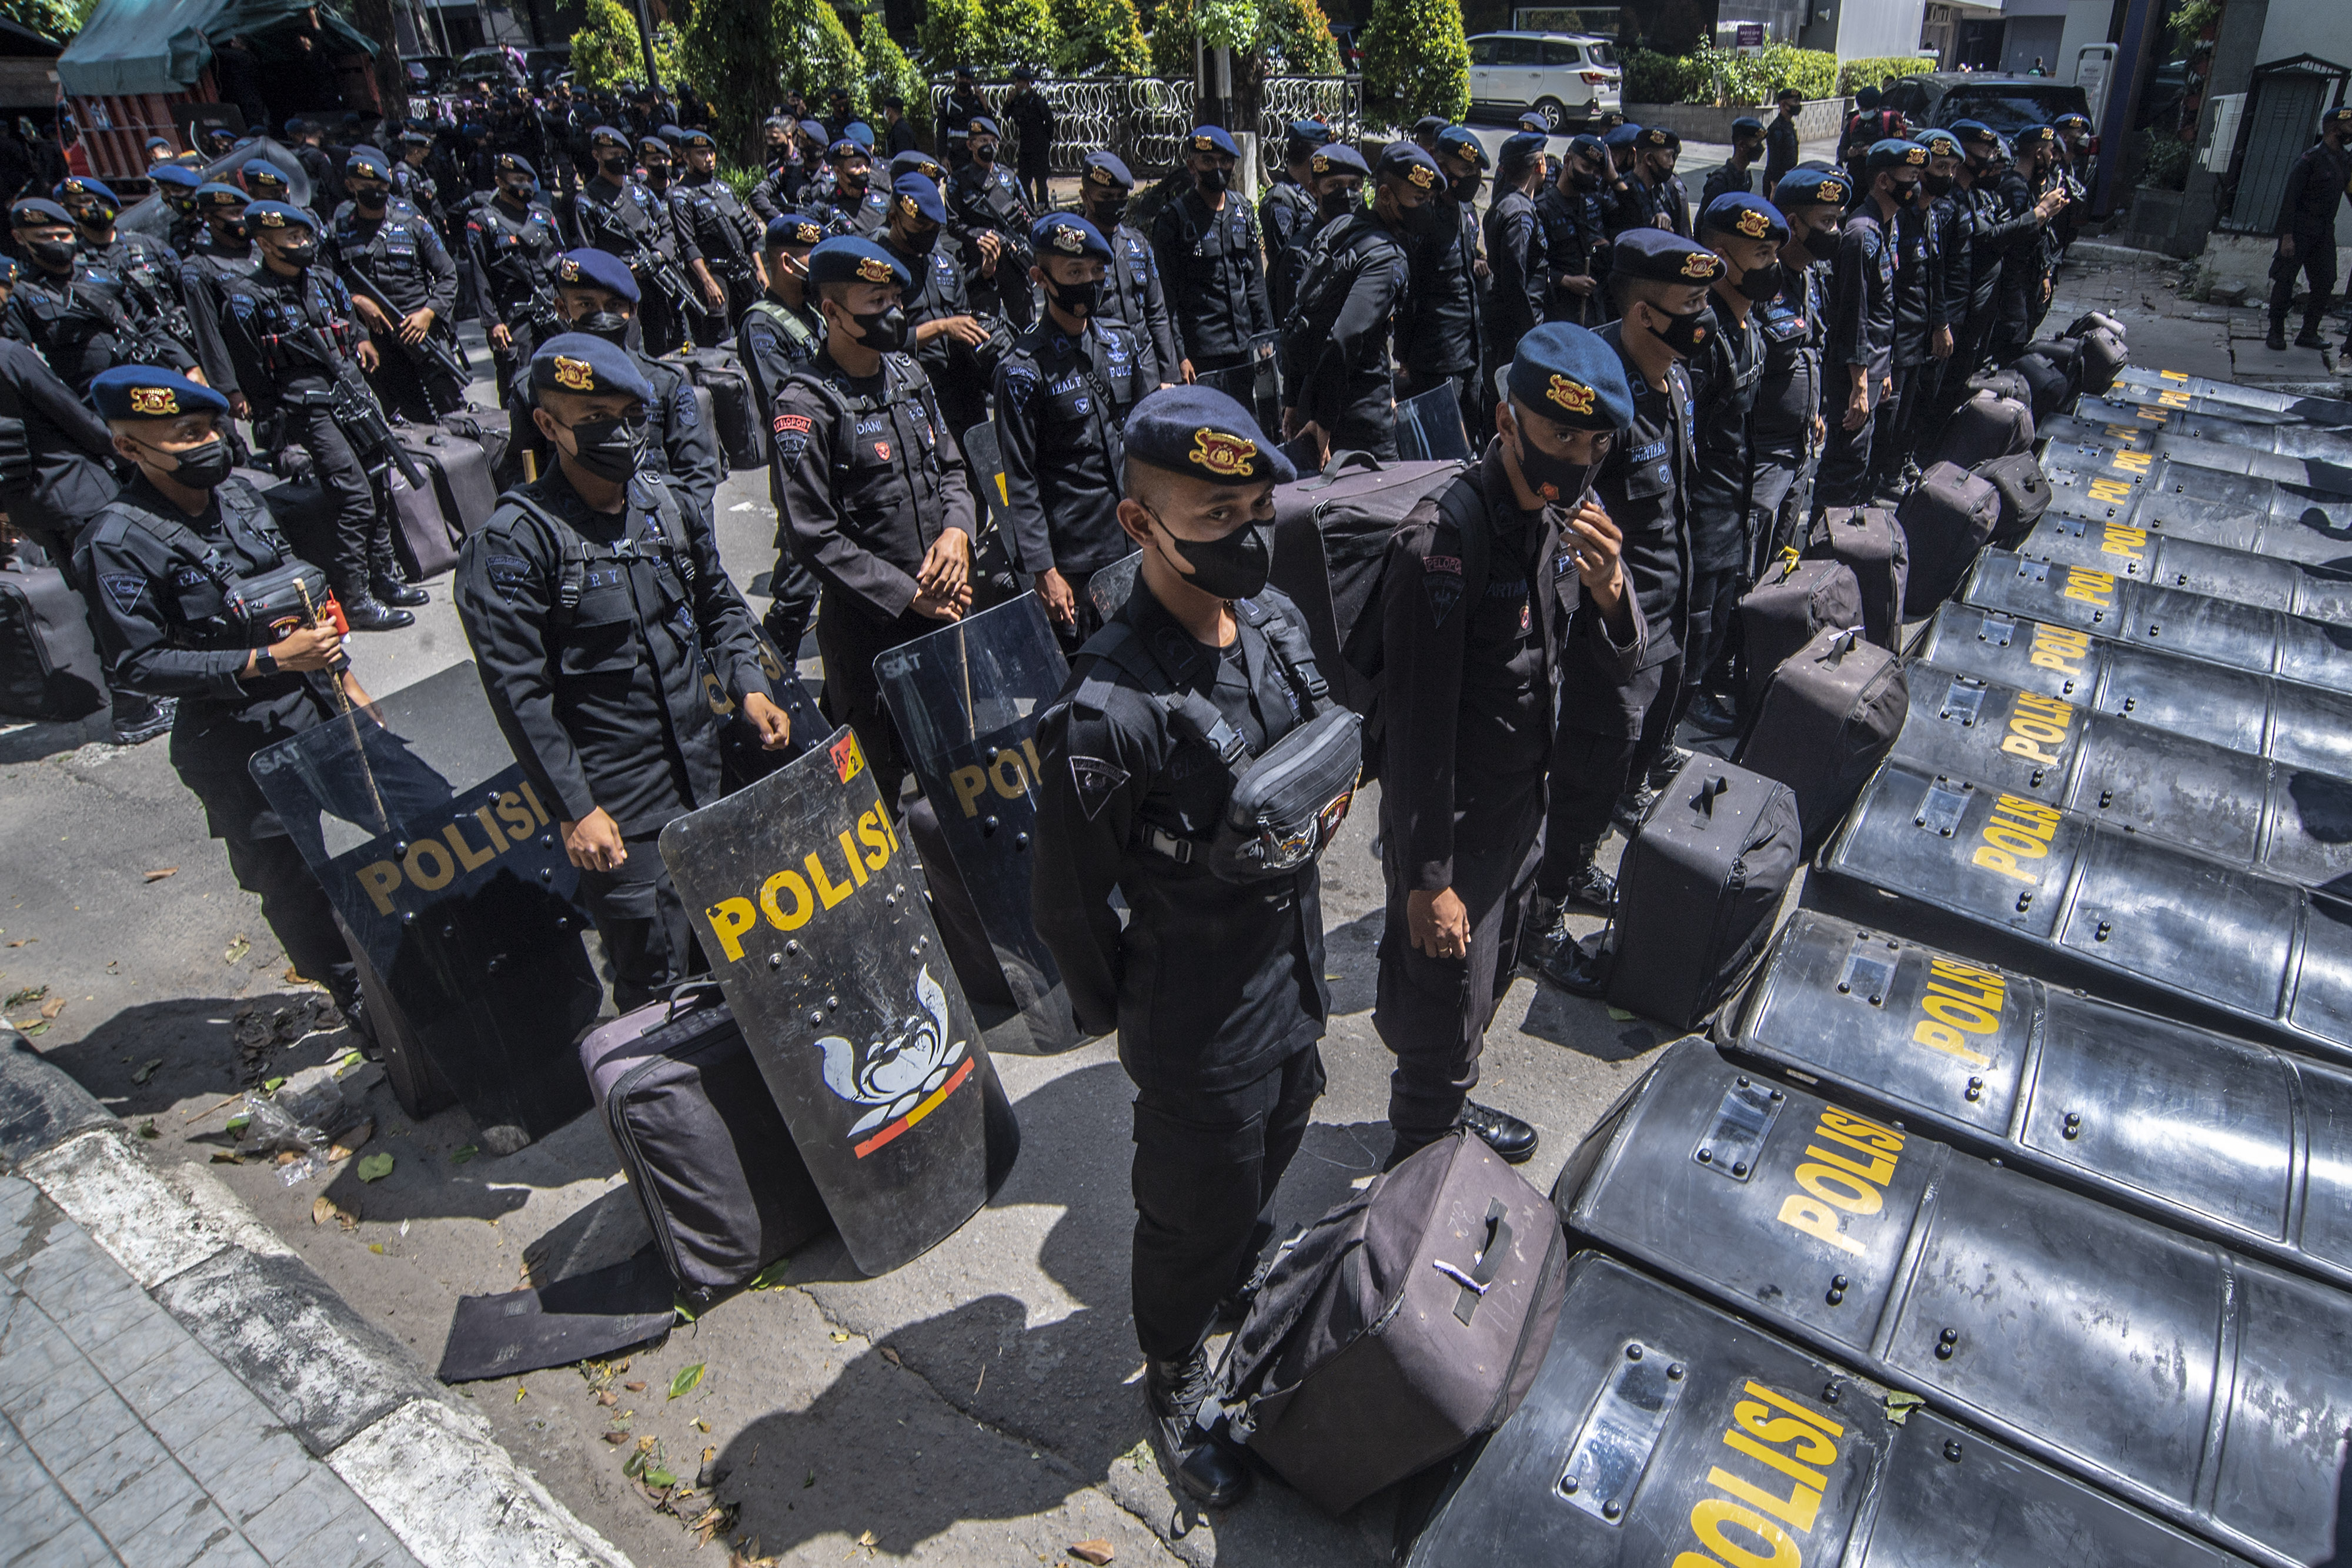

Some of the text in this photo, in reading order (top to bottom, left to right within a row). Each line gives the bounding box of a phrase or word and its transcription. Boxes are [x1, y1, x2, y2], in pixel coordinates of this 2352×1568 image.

[1426, 558, 1462, 573] PELOPO
[355, 781, 550, 917] POLISI
[706, 798, 899, 963] POLISI
[1913, 956, 2006, 1068] POLISI
[1777, 1105, 1906, 1257] POLISI
[1671, 1380, 1845, 1568] OLISI
